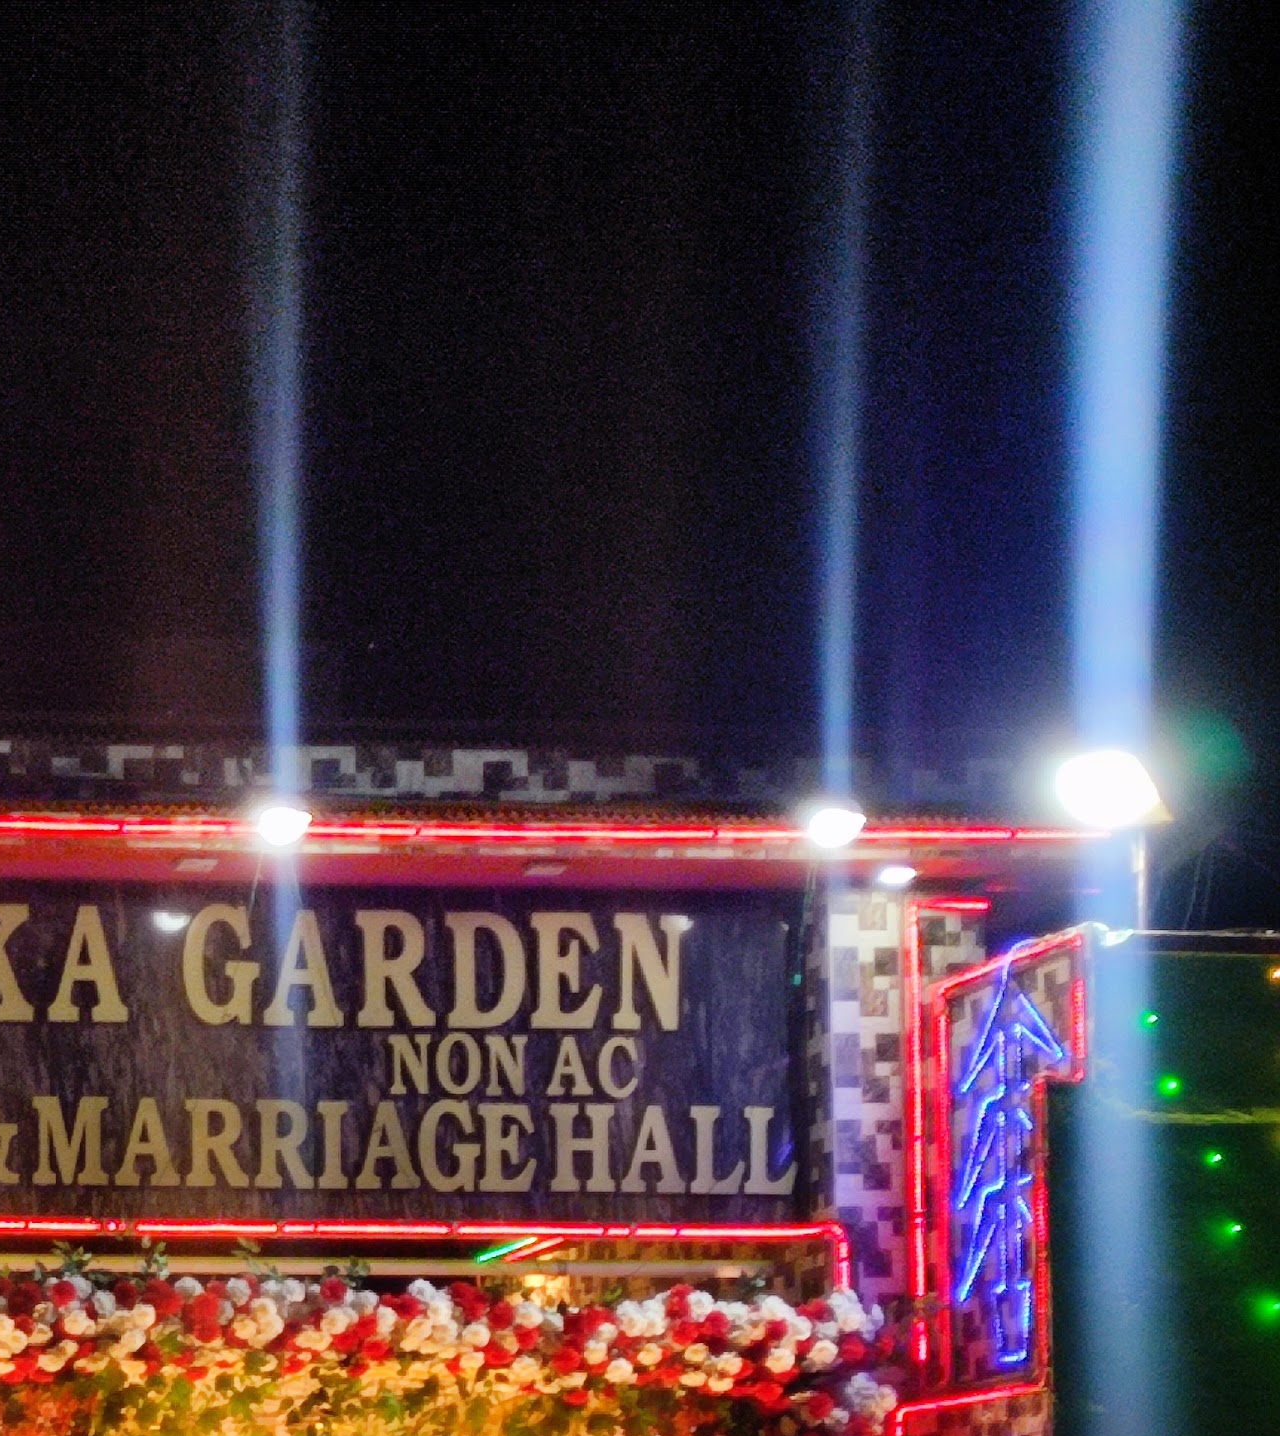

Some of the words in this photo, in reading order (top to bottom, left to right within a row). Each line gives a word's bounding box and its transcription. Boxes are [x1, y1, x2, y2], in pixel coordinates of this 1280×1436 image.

[182, 905, 686, 1029] GARDEN
[390, 1033, 526, 1097] NON
[548, 1036, 638, 1098] AC
